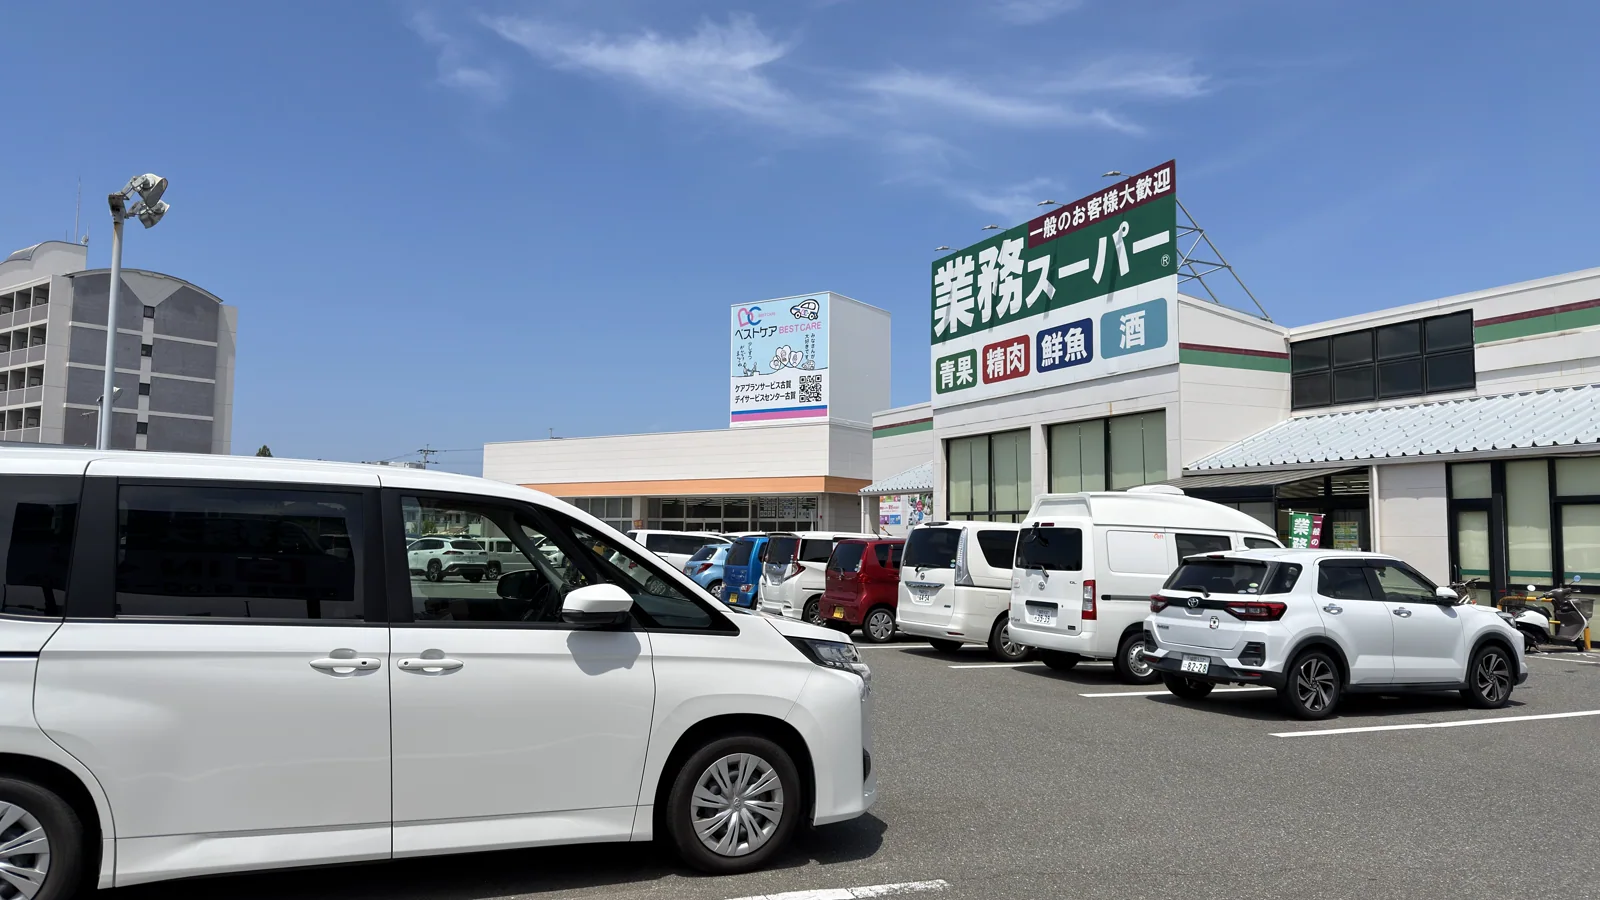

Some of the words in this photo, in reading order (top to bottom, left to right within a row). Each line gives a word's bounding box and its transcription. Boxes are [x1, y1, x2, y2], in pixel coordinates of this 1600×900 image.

[1029, 167, 1171, 239] 一般のお客様大歓迎
[934, 221, 1170, 337] 業務スーパー
[735, 326, 777, 340] ベストケア
[939, 355, 973, 390] 青果
[986, 342, 1025, 379] 精肉
[1040, 327, 1088, 368] 鮮魚
[1119, 310, 1146, 349] 酒
[735, 391, 797, 404] デイサービスセンター古賀
[1186, 661, 1208, 673] 82-28
